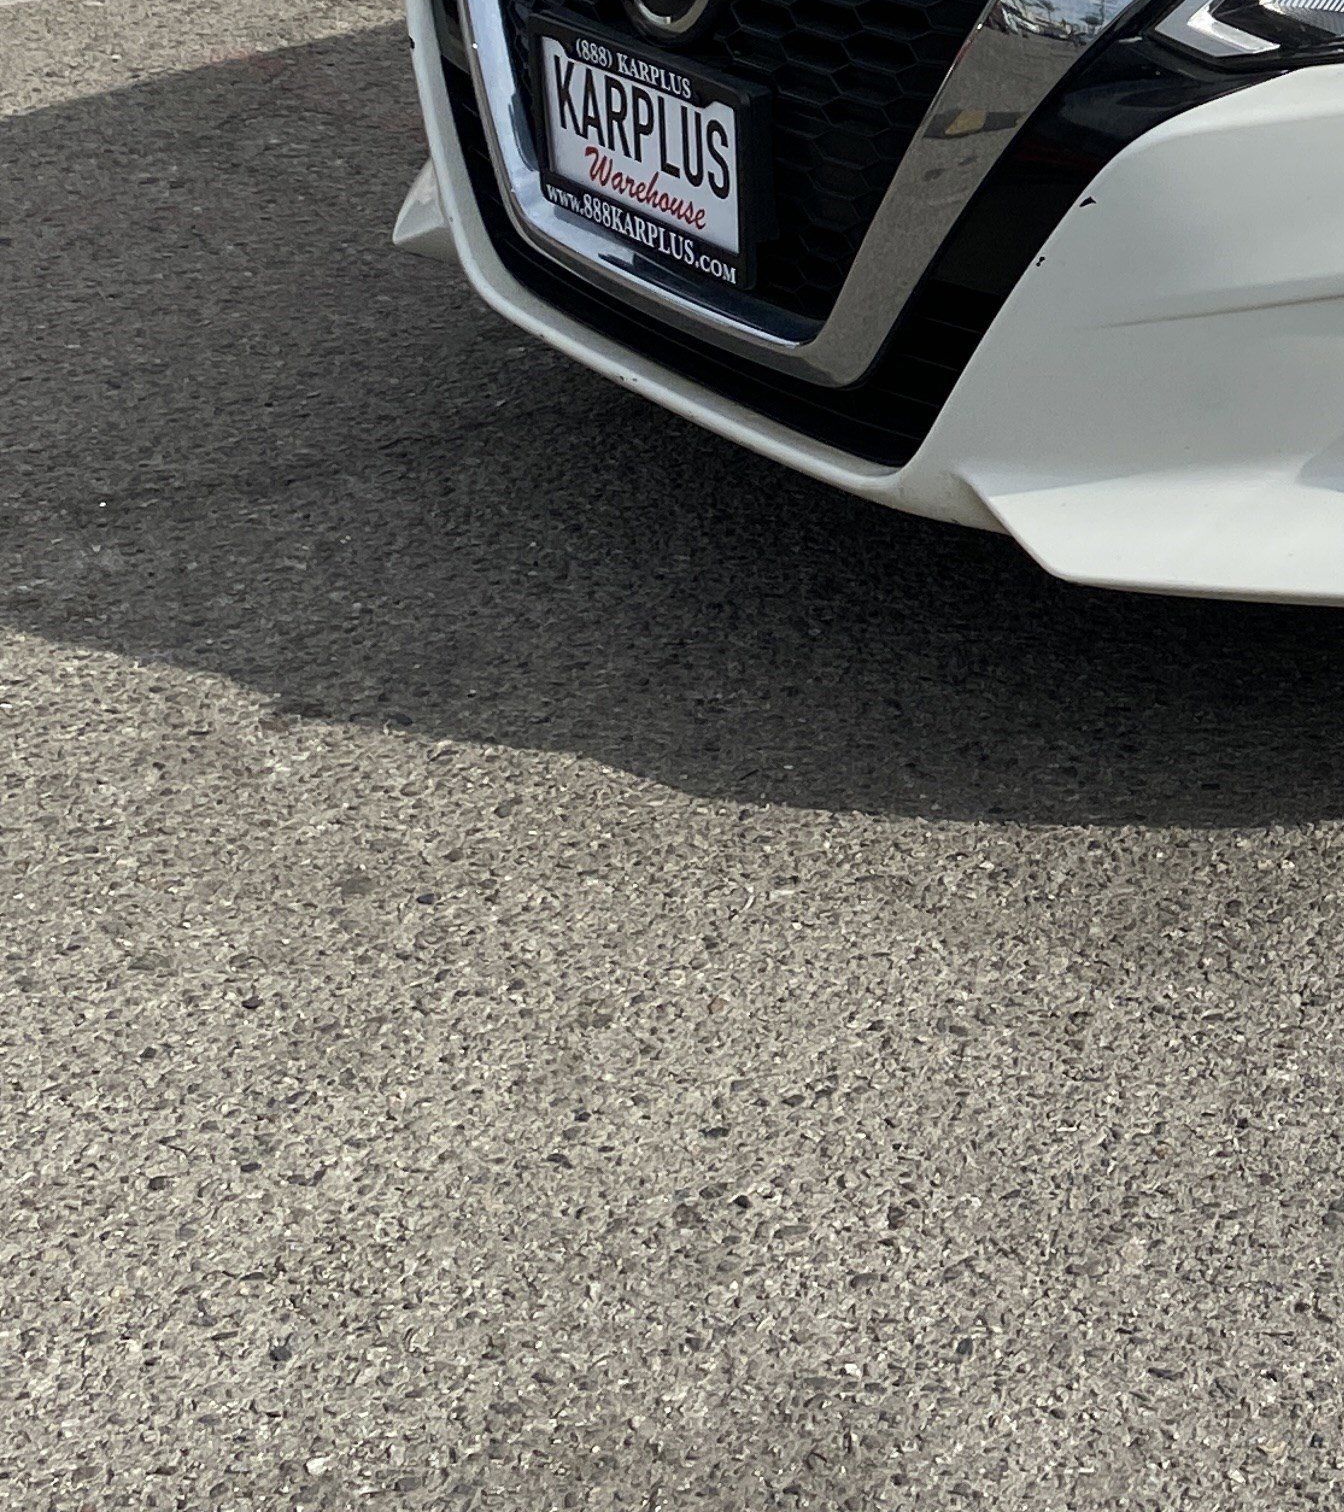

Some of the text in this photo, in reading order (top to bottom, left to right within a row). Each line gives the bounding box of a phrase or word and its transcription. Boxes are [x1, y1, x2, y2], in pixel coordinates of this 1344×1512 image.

[575, 38, 692, 99] (888) KARPLUS
[553, 54, 729, 200] KARPLUS
[584, 145, 707, 230] Warehouse
